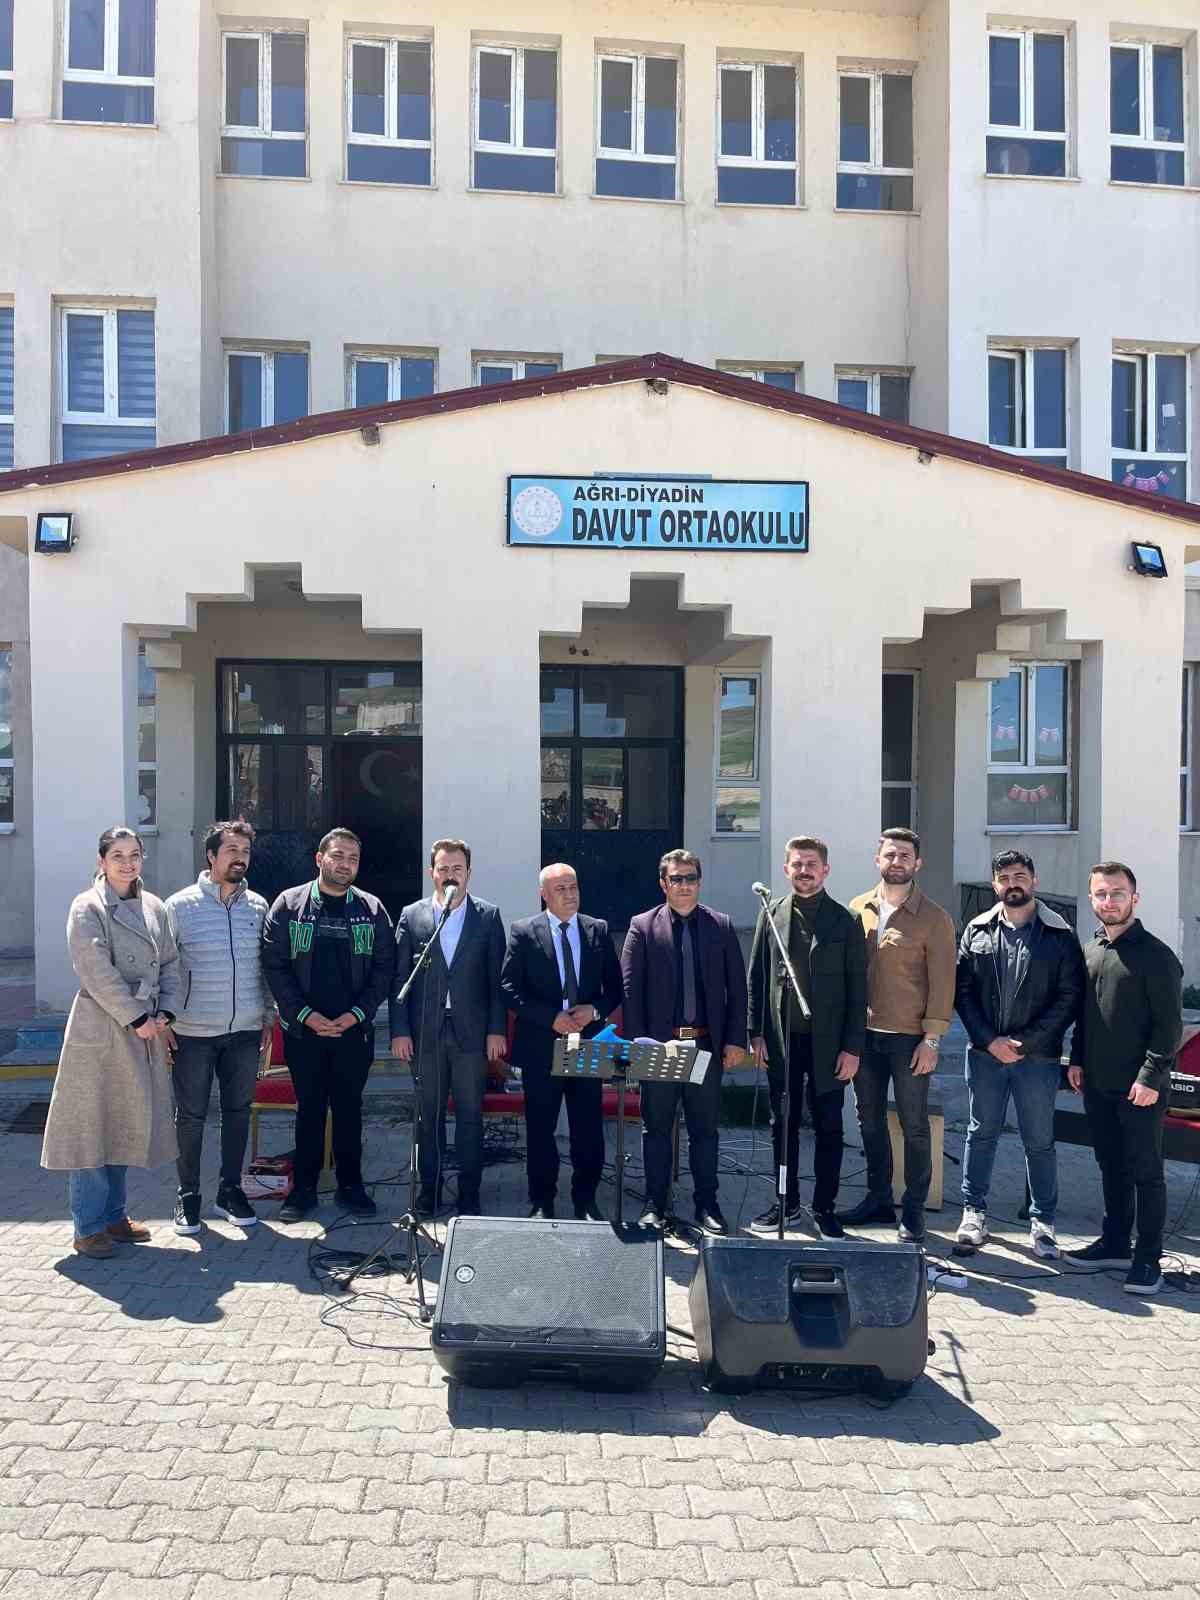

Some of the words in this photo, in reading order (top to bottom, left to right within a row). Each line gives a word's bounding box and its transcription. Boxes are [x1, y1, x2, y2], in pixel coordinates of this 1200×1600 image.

[573, 482, 705, 504] AĞRI-DİYADİN
[572, 507, 653, 543] DAVUT
[659, 509, 805, 545] ORTAOKULU
